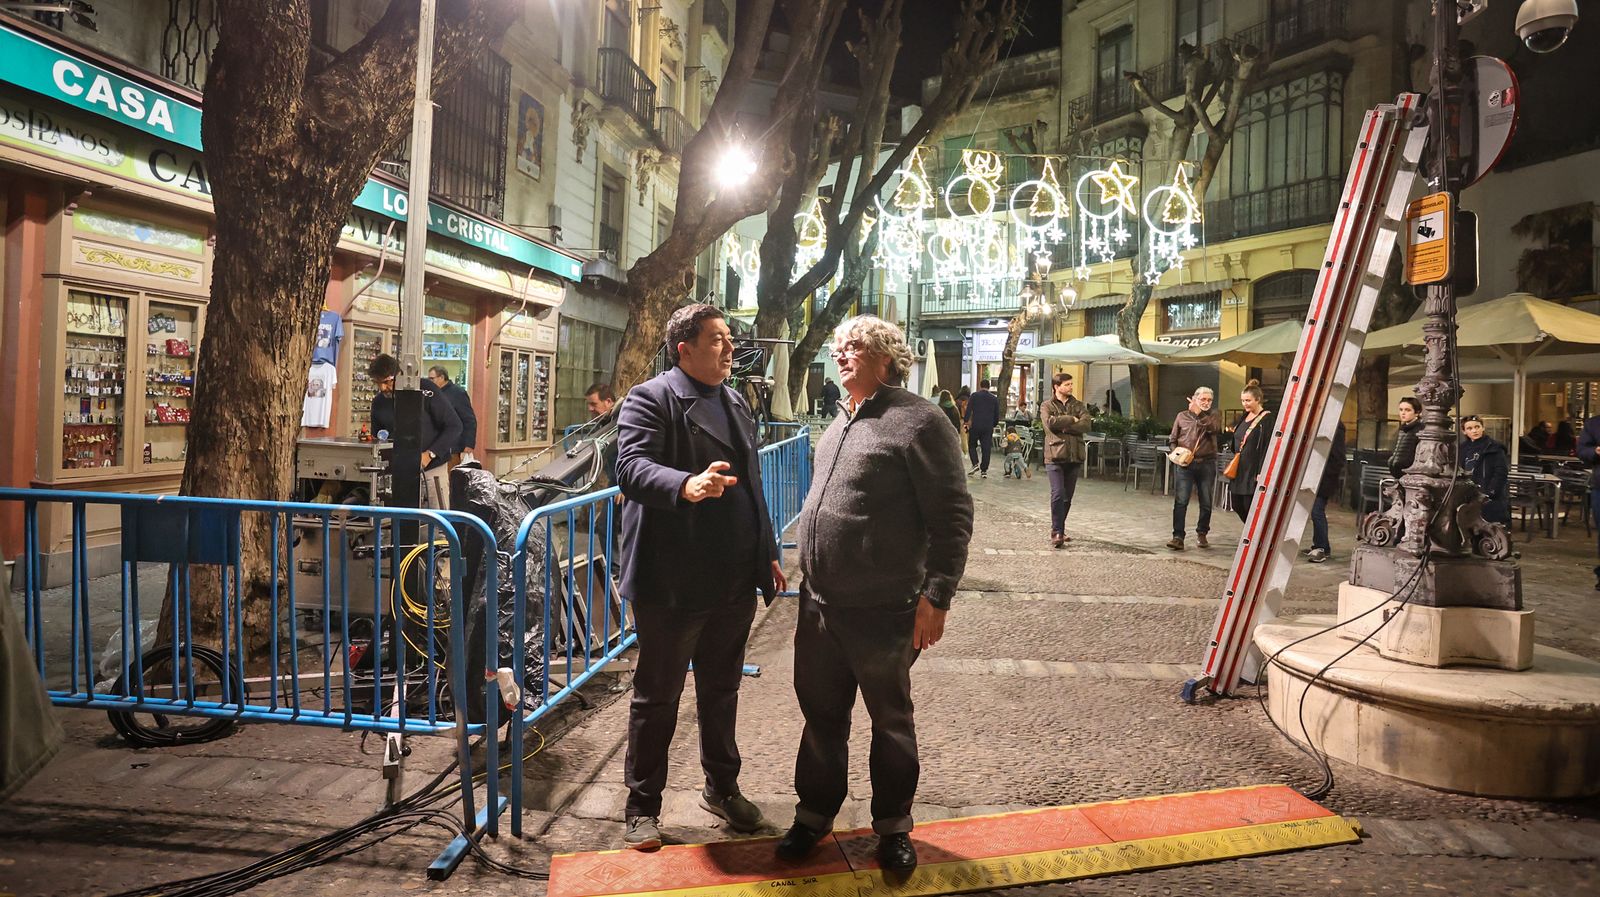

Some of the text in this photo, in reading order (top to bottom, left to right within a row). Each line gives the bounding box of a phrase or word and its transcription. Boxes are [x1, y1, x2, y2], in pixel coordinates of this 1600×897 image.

[52, 59, 174, 134] CASA
[382, 187, 433, 226] LO
[446, 214, 509, 251] CRISTAL
[770, 876, 818, 888] CANAL SUR
